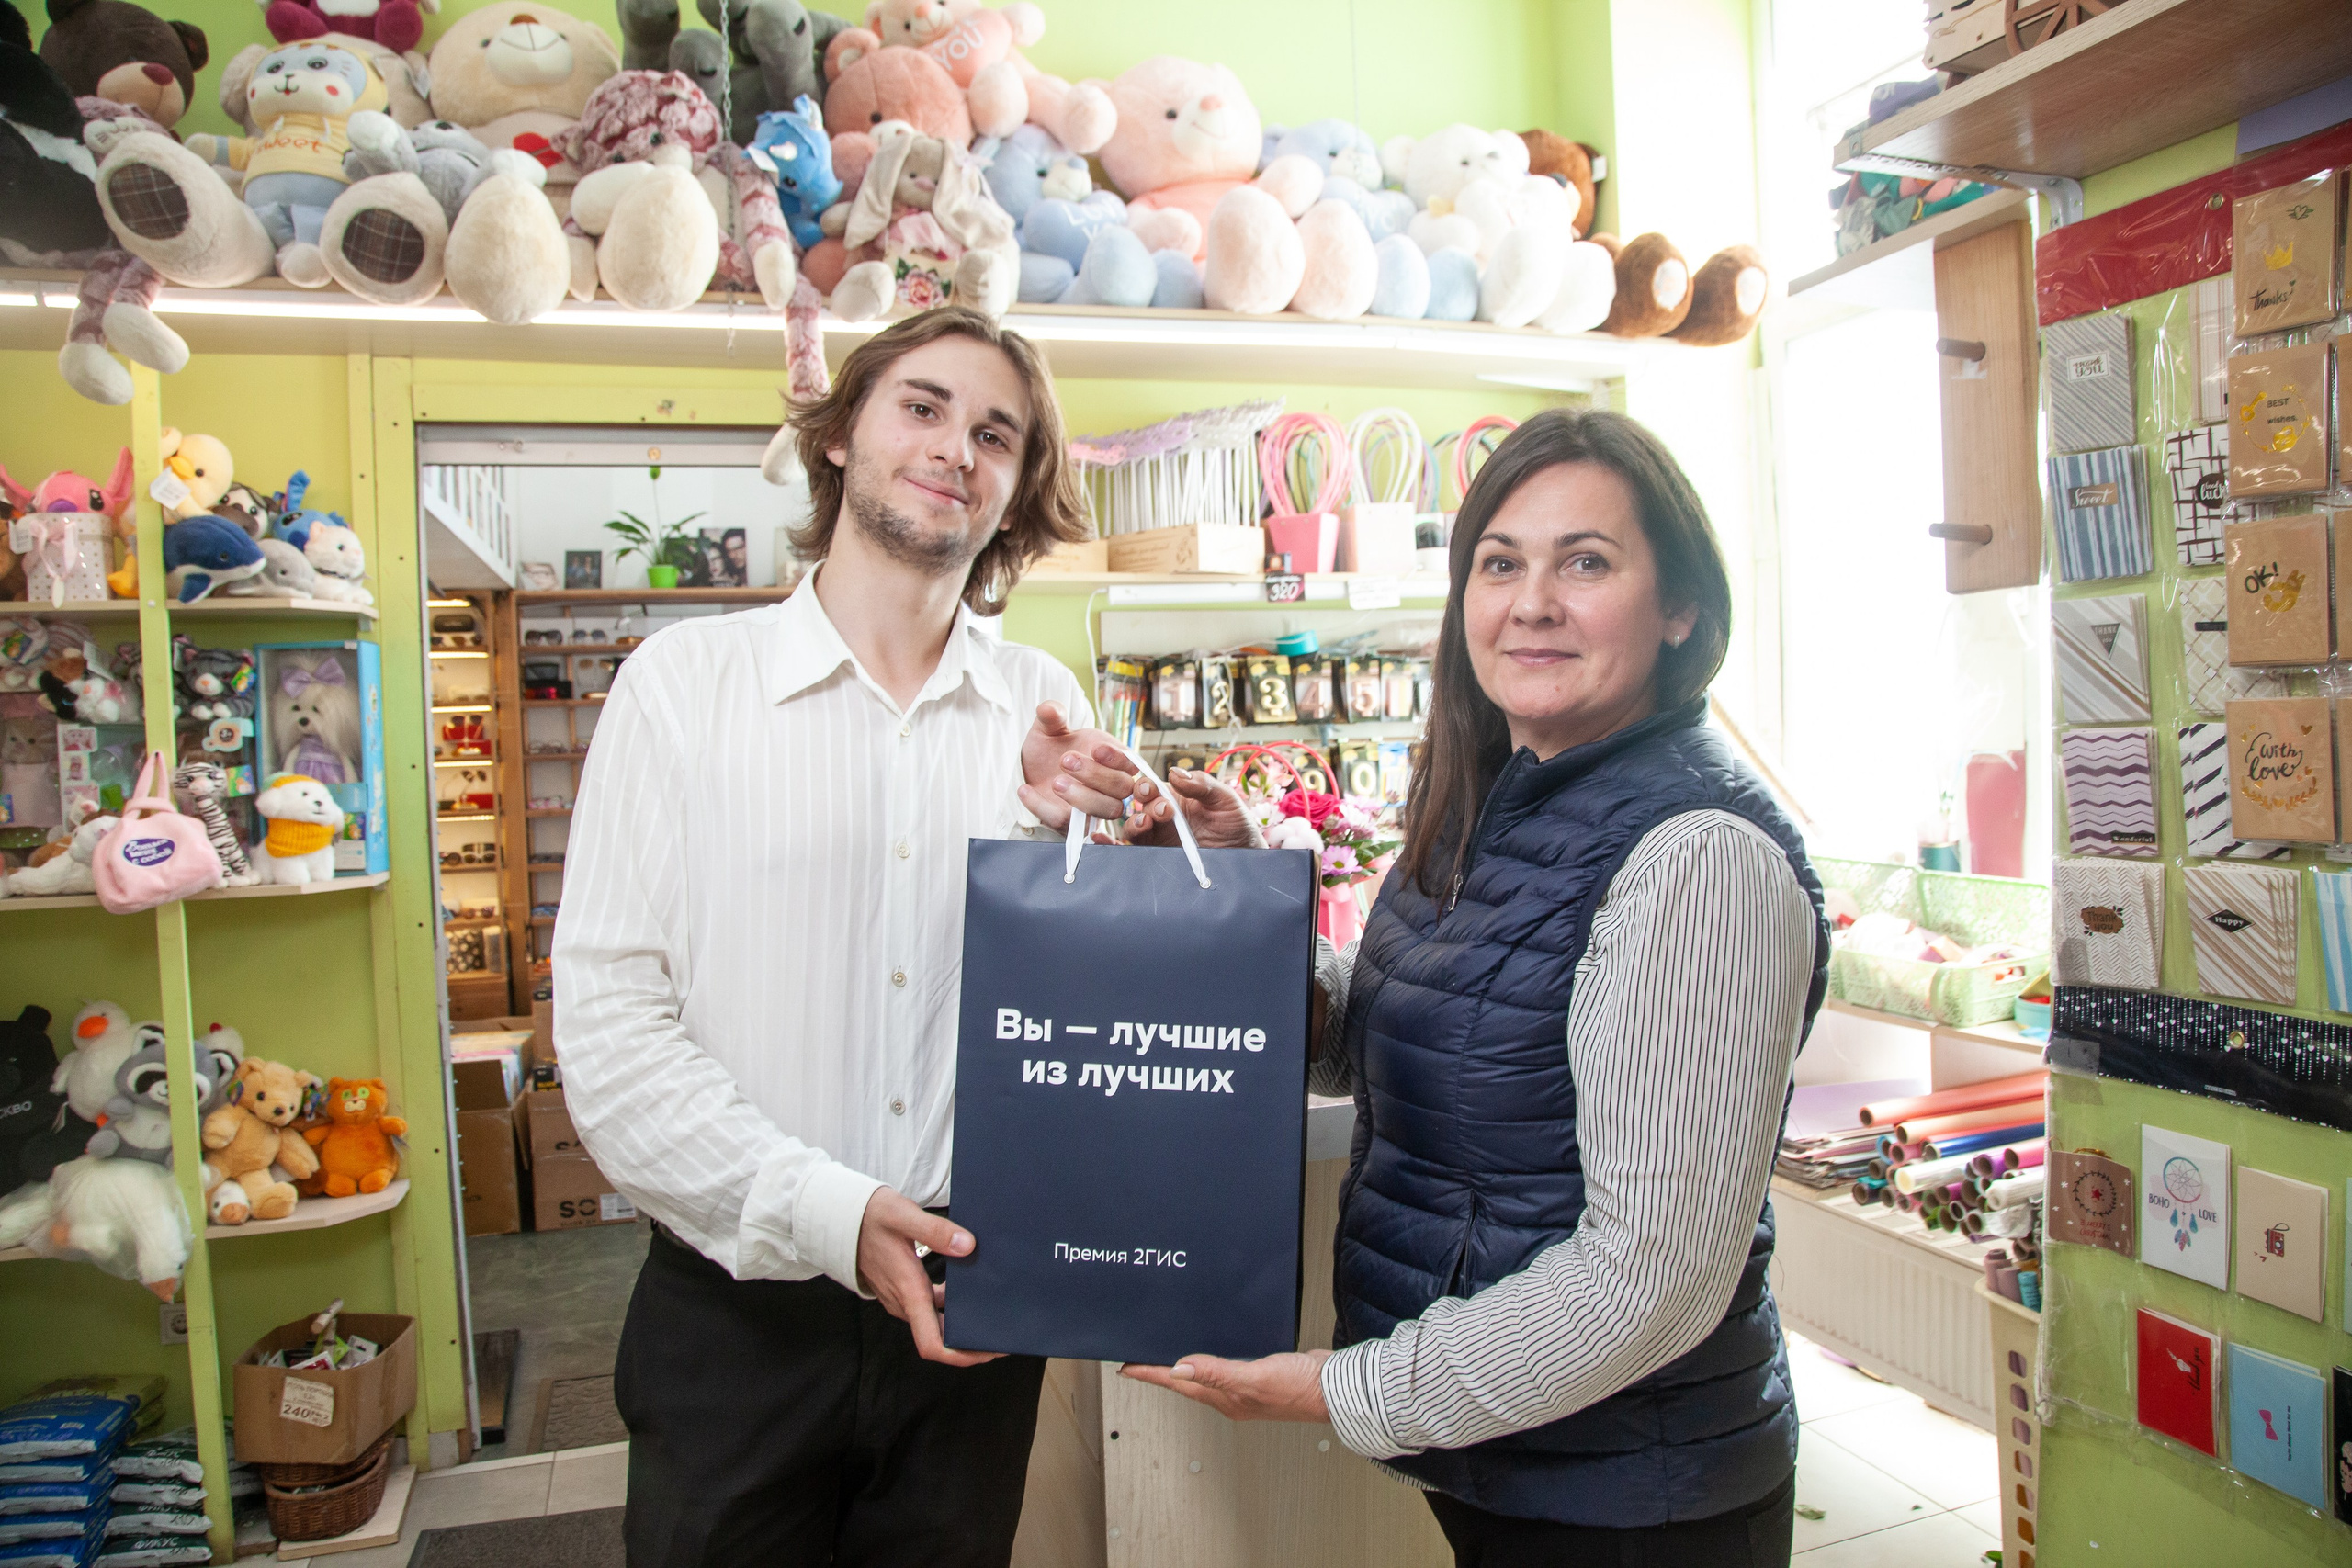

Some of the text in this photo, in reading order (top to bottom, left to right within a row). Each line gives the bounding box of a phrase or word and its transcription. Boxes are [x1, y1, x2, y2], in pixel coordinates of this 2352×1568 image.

[933, 27, 983, 71] YOU
[2249, 288, 2291, 311] Thanks
[2267, 397, 2290, 408] BEST
[2075, 488, 2113, 507] Sweet
[2245, 561, 2278, 593] OK!
[1269, 583, 1300, 602] 320
[1260, 678, 1286, 716] 3
[1298, 681, 1324, 719] 4
[2260, 742, 2298, 759] with
[2248, 756, 2297, 781] love
[2112, 835, 2154, 843] Wonderful
[2086, 911, 2117, 922] Thank
[2094, 923, 2113, 931] you
[2214, 916, 2244, 927] Happy
[996, 1008, 1052, 1042] Вы
[1110, 1022, 1267, 1055] лучшие
[1023, 1059, 1235, 1097] из лучших
[2148, 1193, 2218, 1223] BOHO LOVE
[1054, 1242, 1187, 1268] Премия 2ГИС
[283, 1404, 310, 1418] 240
[132, 1537, 179, 1550] ФИКУС
